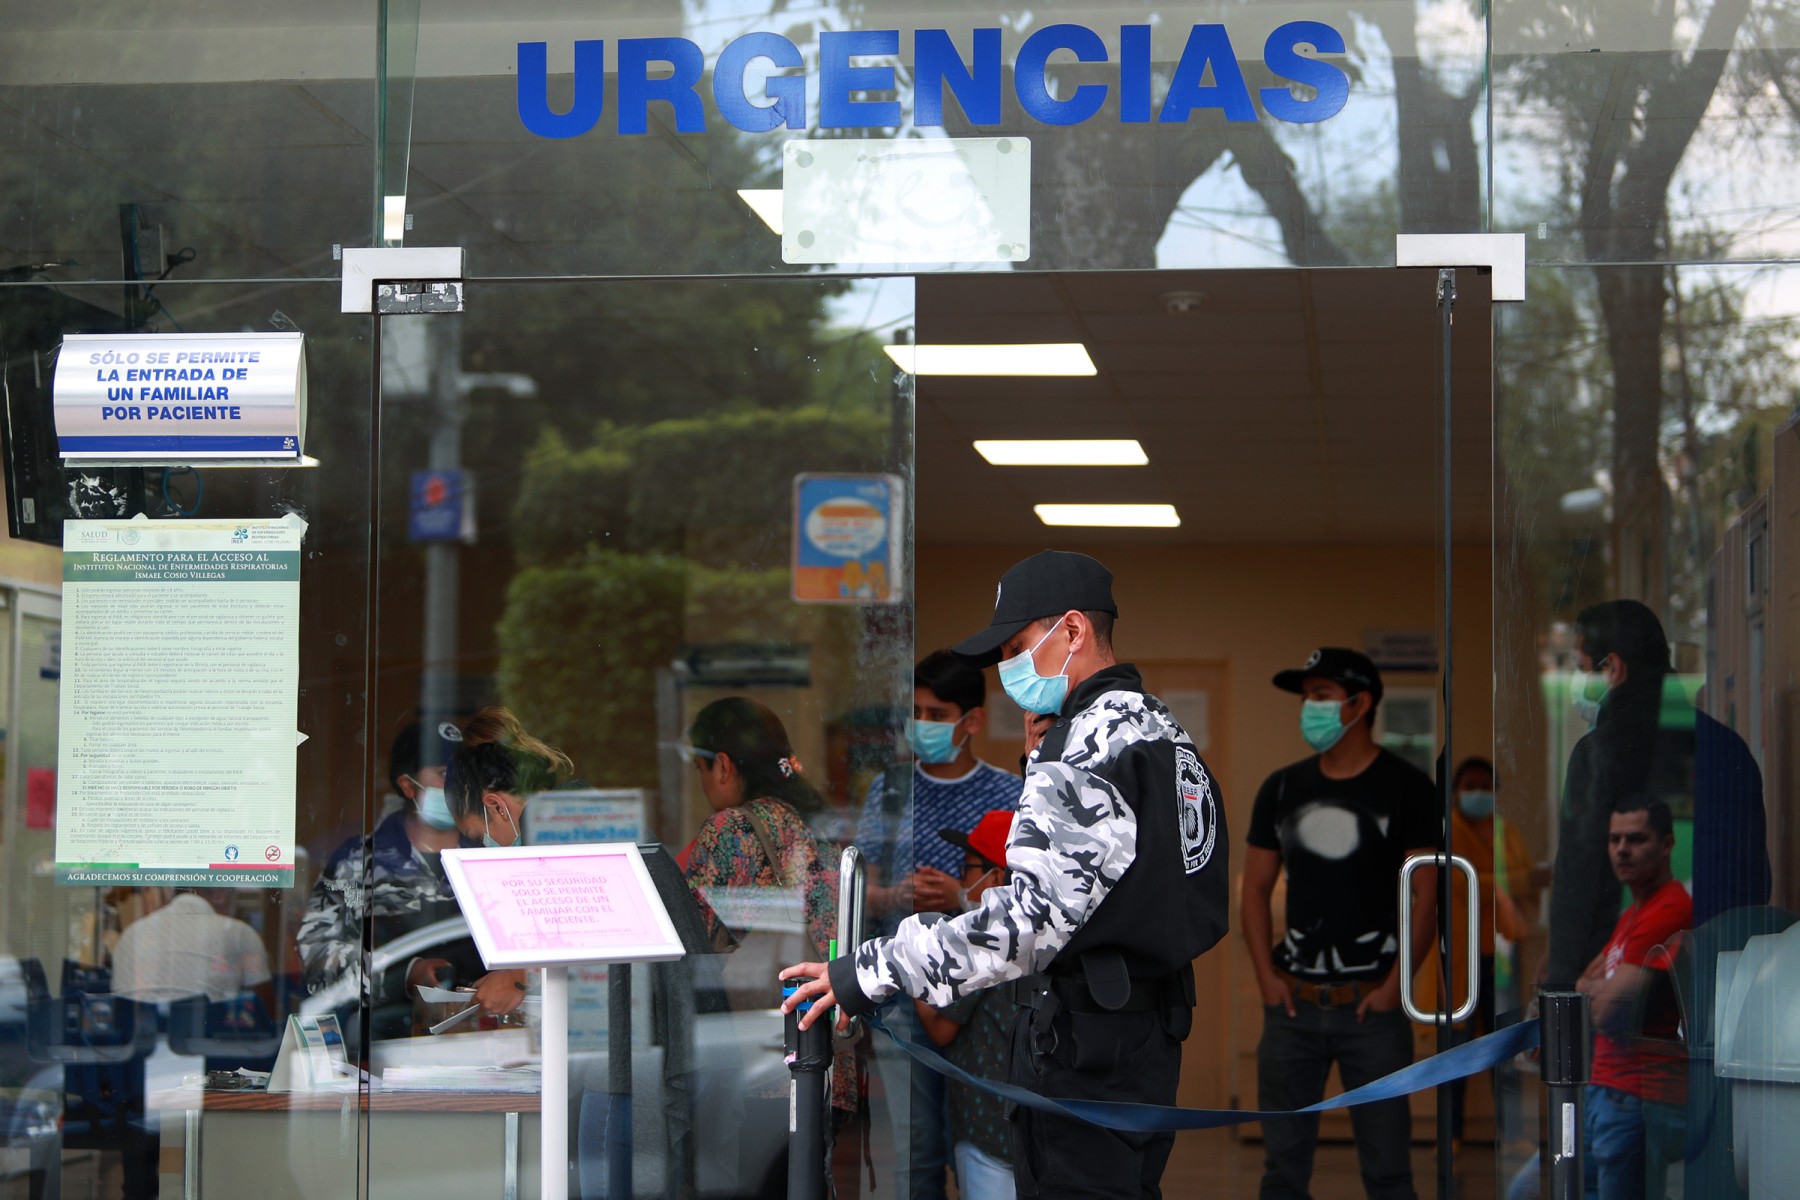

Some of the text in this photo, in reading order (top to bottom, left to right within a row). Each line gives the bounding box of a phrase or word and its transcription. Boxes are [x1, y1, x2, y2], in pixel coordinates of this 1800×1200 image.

[518, 21, 1349, 139] URGENCIAS
[90, 349, 261, 365] SÓLO SE PERMITE
[97, 368, 248, 382] LA ENTRADA DE
[107, 387, 229, 401] UN FAMILIAR
[103, 406, 241, 420] POR PACIENTE
[93, 553, 164, 562] REGLAMENTO
[168, 554, 194, 562] PARA
[211, 553, 253, 561] ACCESO
[145, 873, 206, 881] COMPRENSIÓN
[216, 874, 279, 882] COOPERACIÓN
[544, 877, 607, 886] SEGURIDAD
[512, 889, 540, 897] SOLO
[559, 886, 606, 894] PERMITE
[532, 896, 573, 905] ACCESO
[521, 906, 573, 916] FAMILIAR
[544, 915, 599, 924] PACIENTE.
